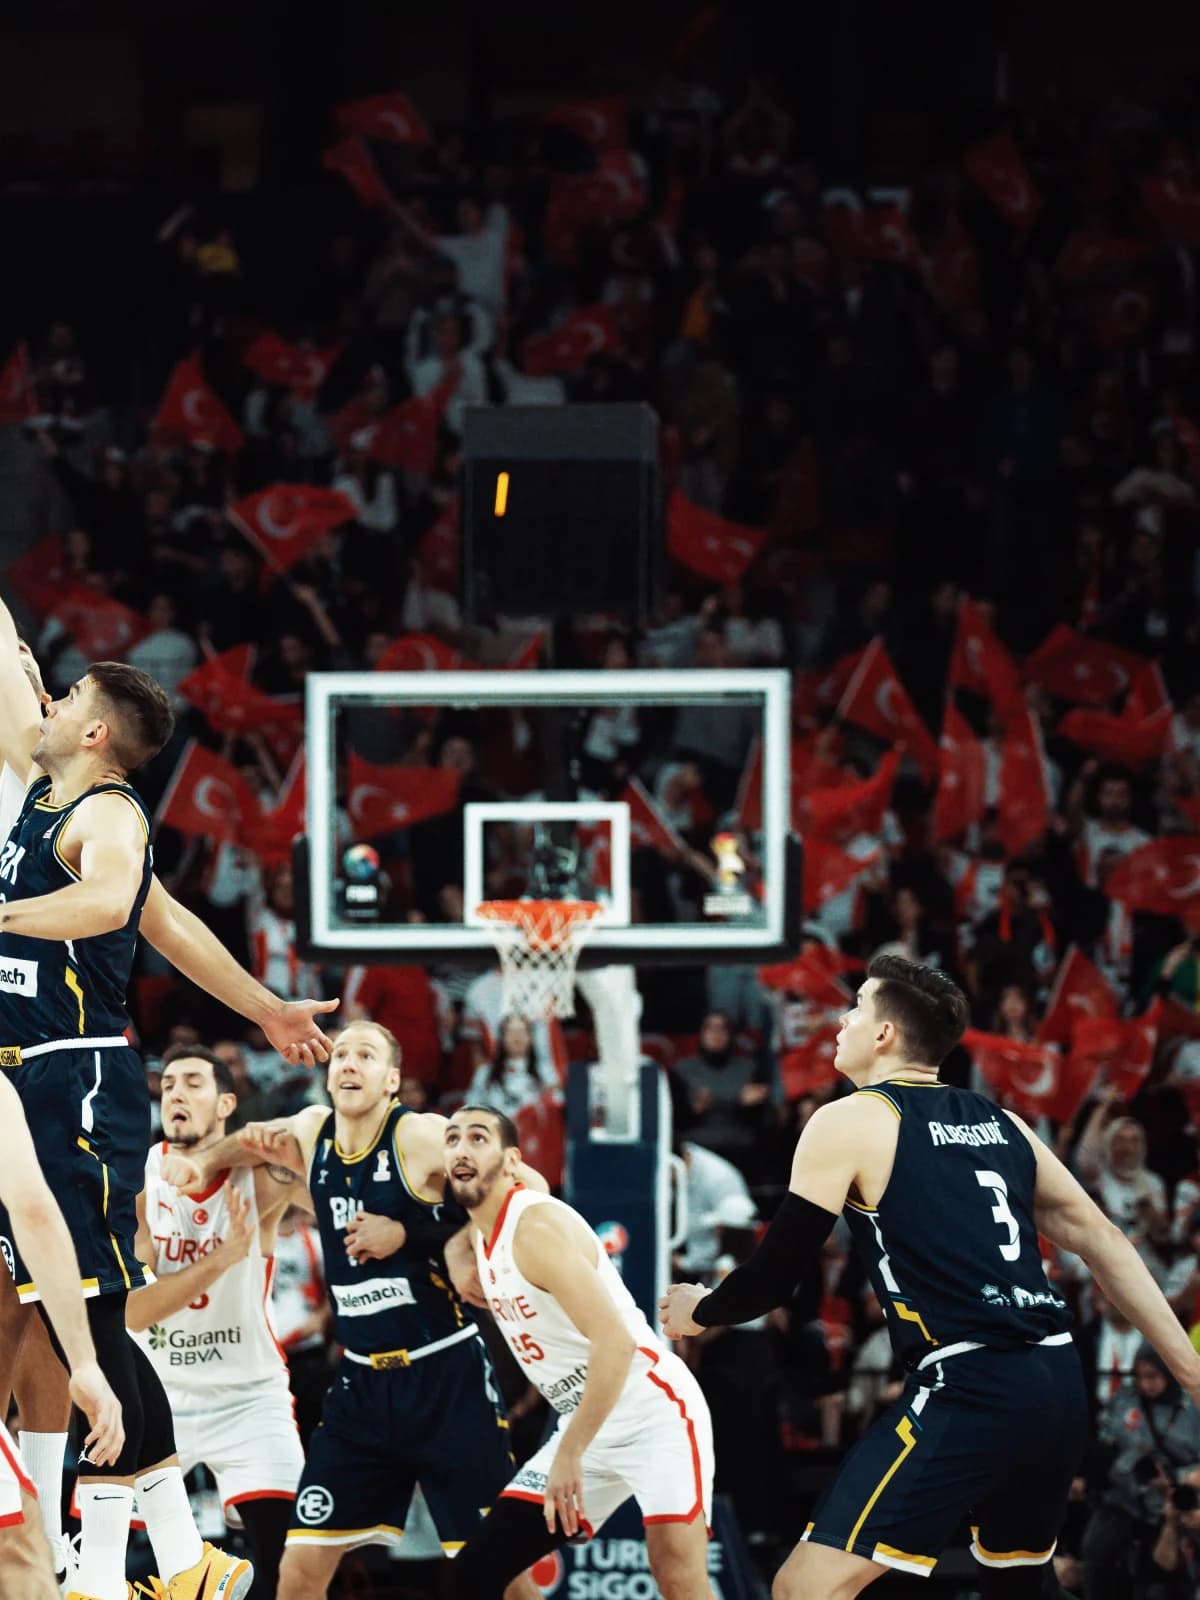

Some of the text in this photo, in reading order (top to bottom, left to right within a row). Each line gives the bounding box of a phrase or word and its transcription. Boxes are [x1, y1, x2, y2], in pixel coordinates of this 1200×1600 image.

[974, 1170, 1021, 1262] 3
[169, 1326, 241, 1349] Garanti
[170, 1346, 223, 1366] BBVA
